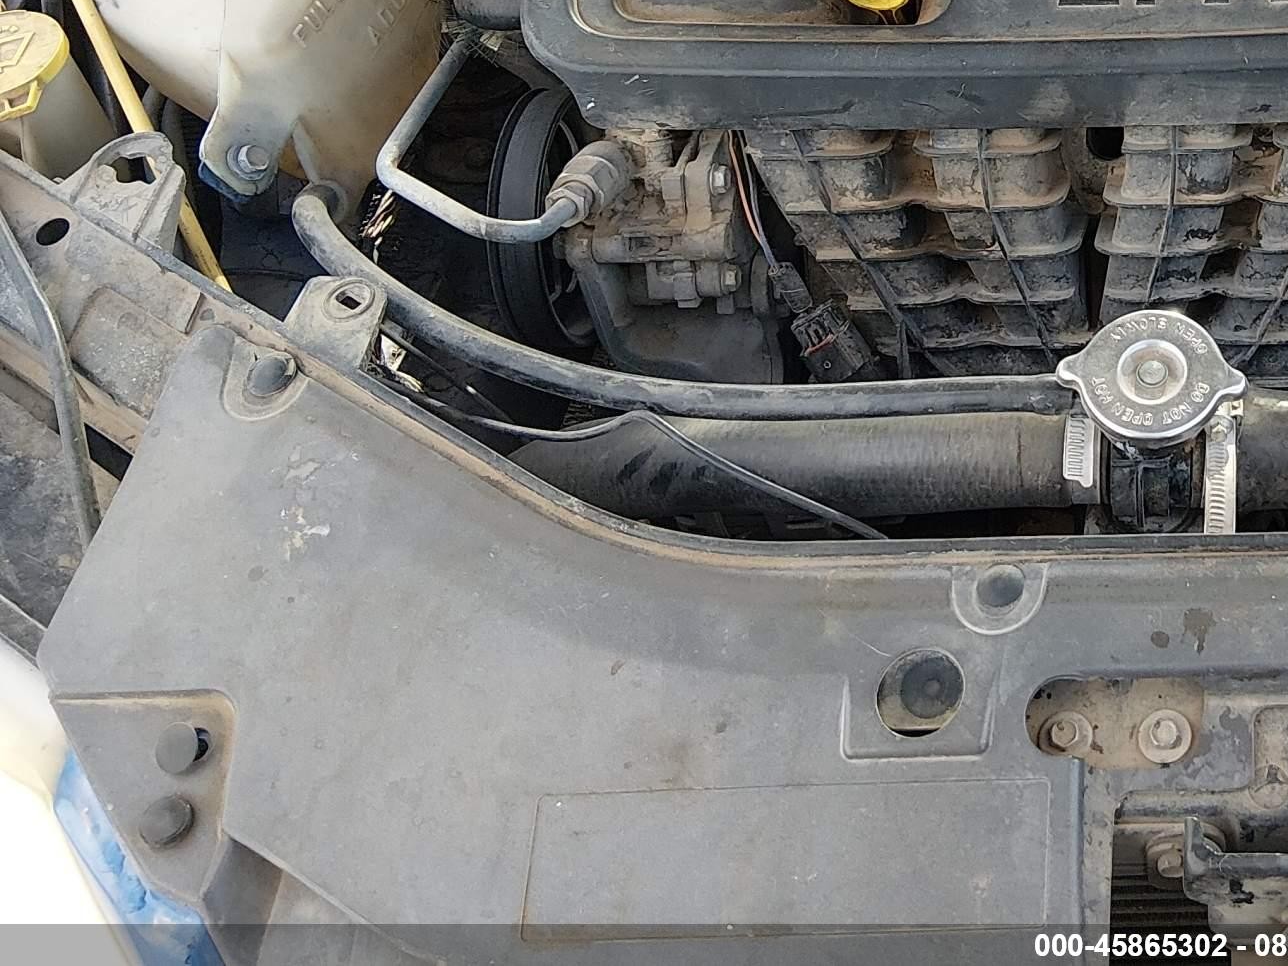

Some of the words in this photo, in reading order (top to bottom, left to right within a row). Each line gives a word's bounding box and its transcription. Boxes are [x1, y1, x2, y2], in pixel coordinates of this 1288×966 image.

[1174, 321, 1209, 355] OPEN
[1091, 376, 1115, 405] HOT
[1191, 381, 1211, 403] DO
[1111, 401, 1154, 426] OPEN
[1162, 400, 1193, 425] NOT
